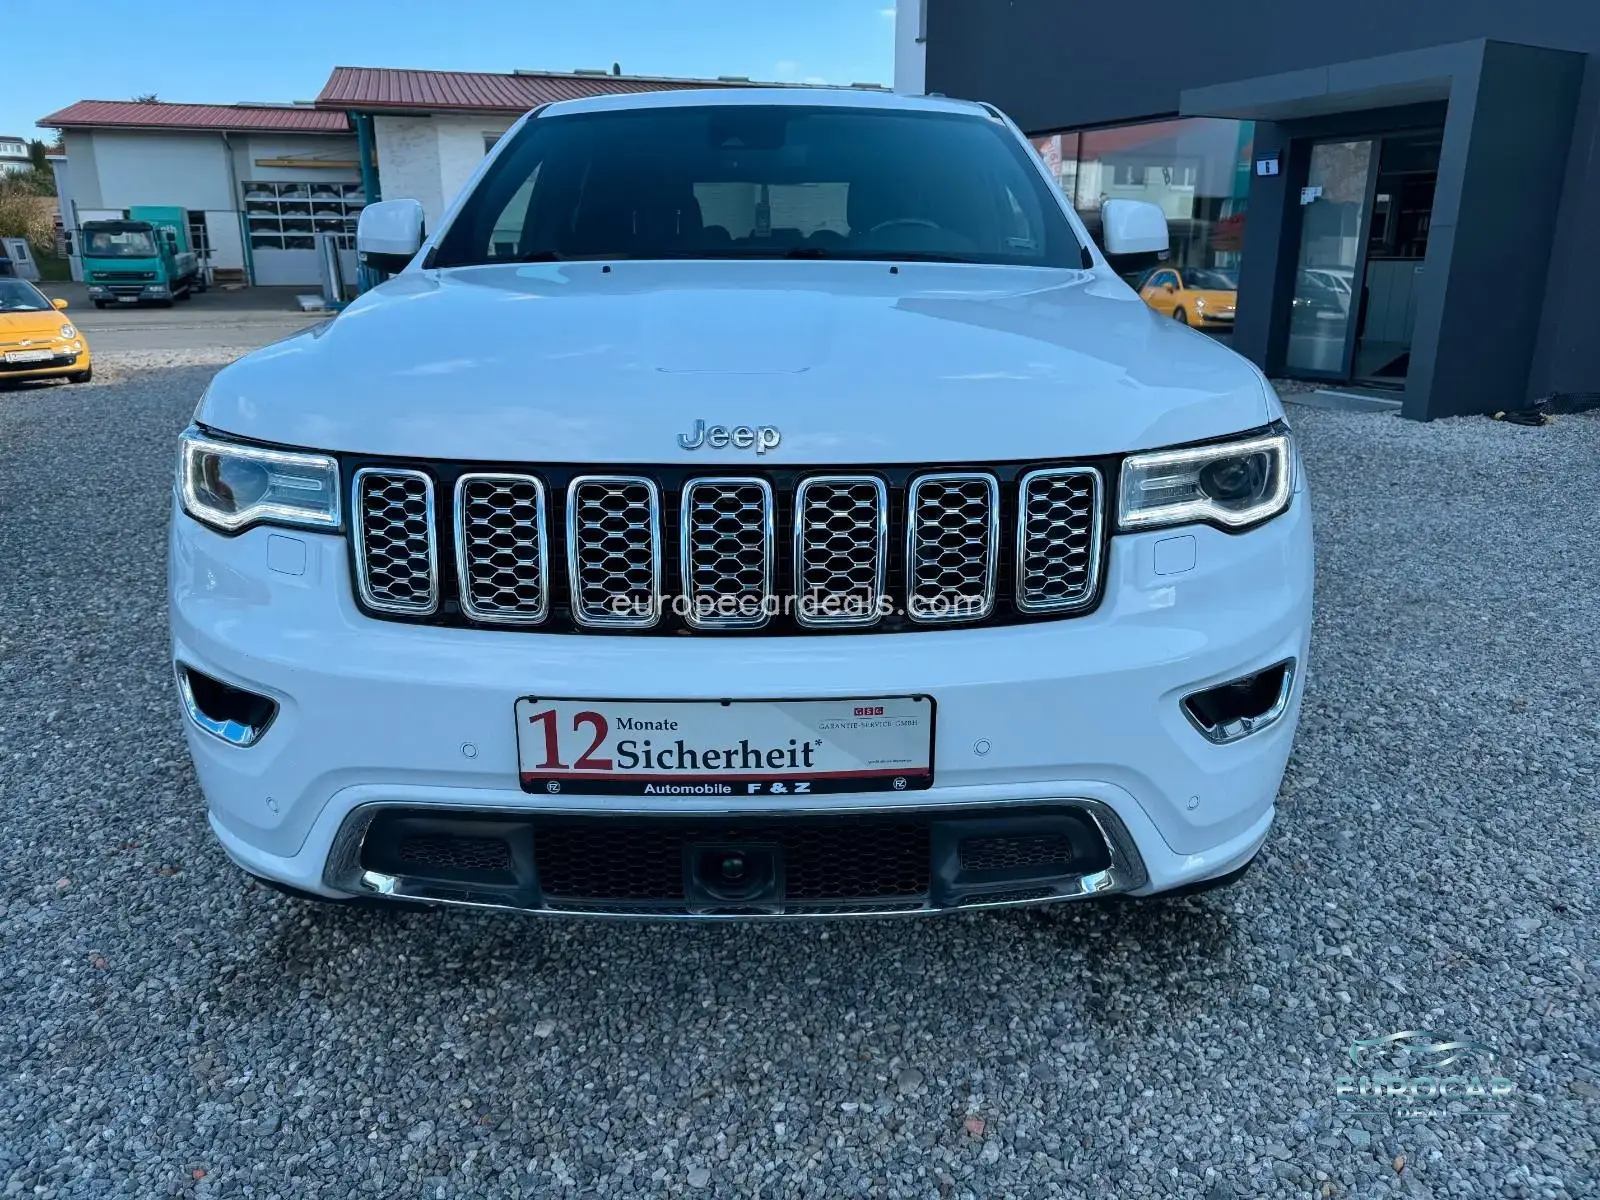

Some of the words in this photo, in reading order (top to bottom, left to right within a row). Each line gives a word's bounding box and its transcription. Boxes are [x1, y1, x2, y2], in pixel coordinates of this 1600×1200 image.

[676, 419, 781, 455] Jeep
[616, 717, 679, 731] Monate
[528, 709, 613, 770] 12
[644, 783, 732, 794] Automobile
[748, 783, 762, 794] F
[769, 782, 788, 793] &
[794, 782, 811, 793] Z
